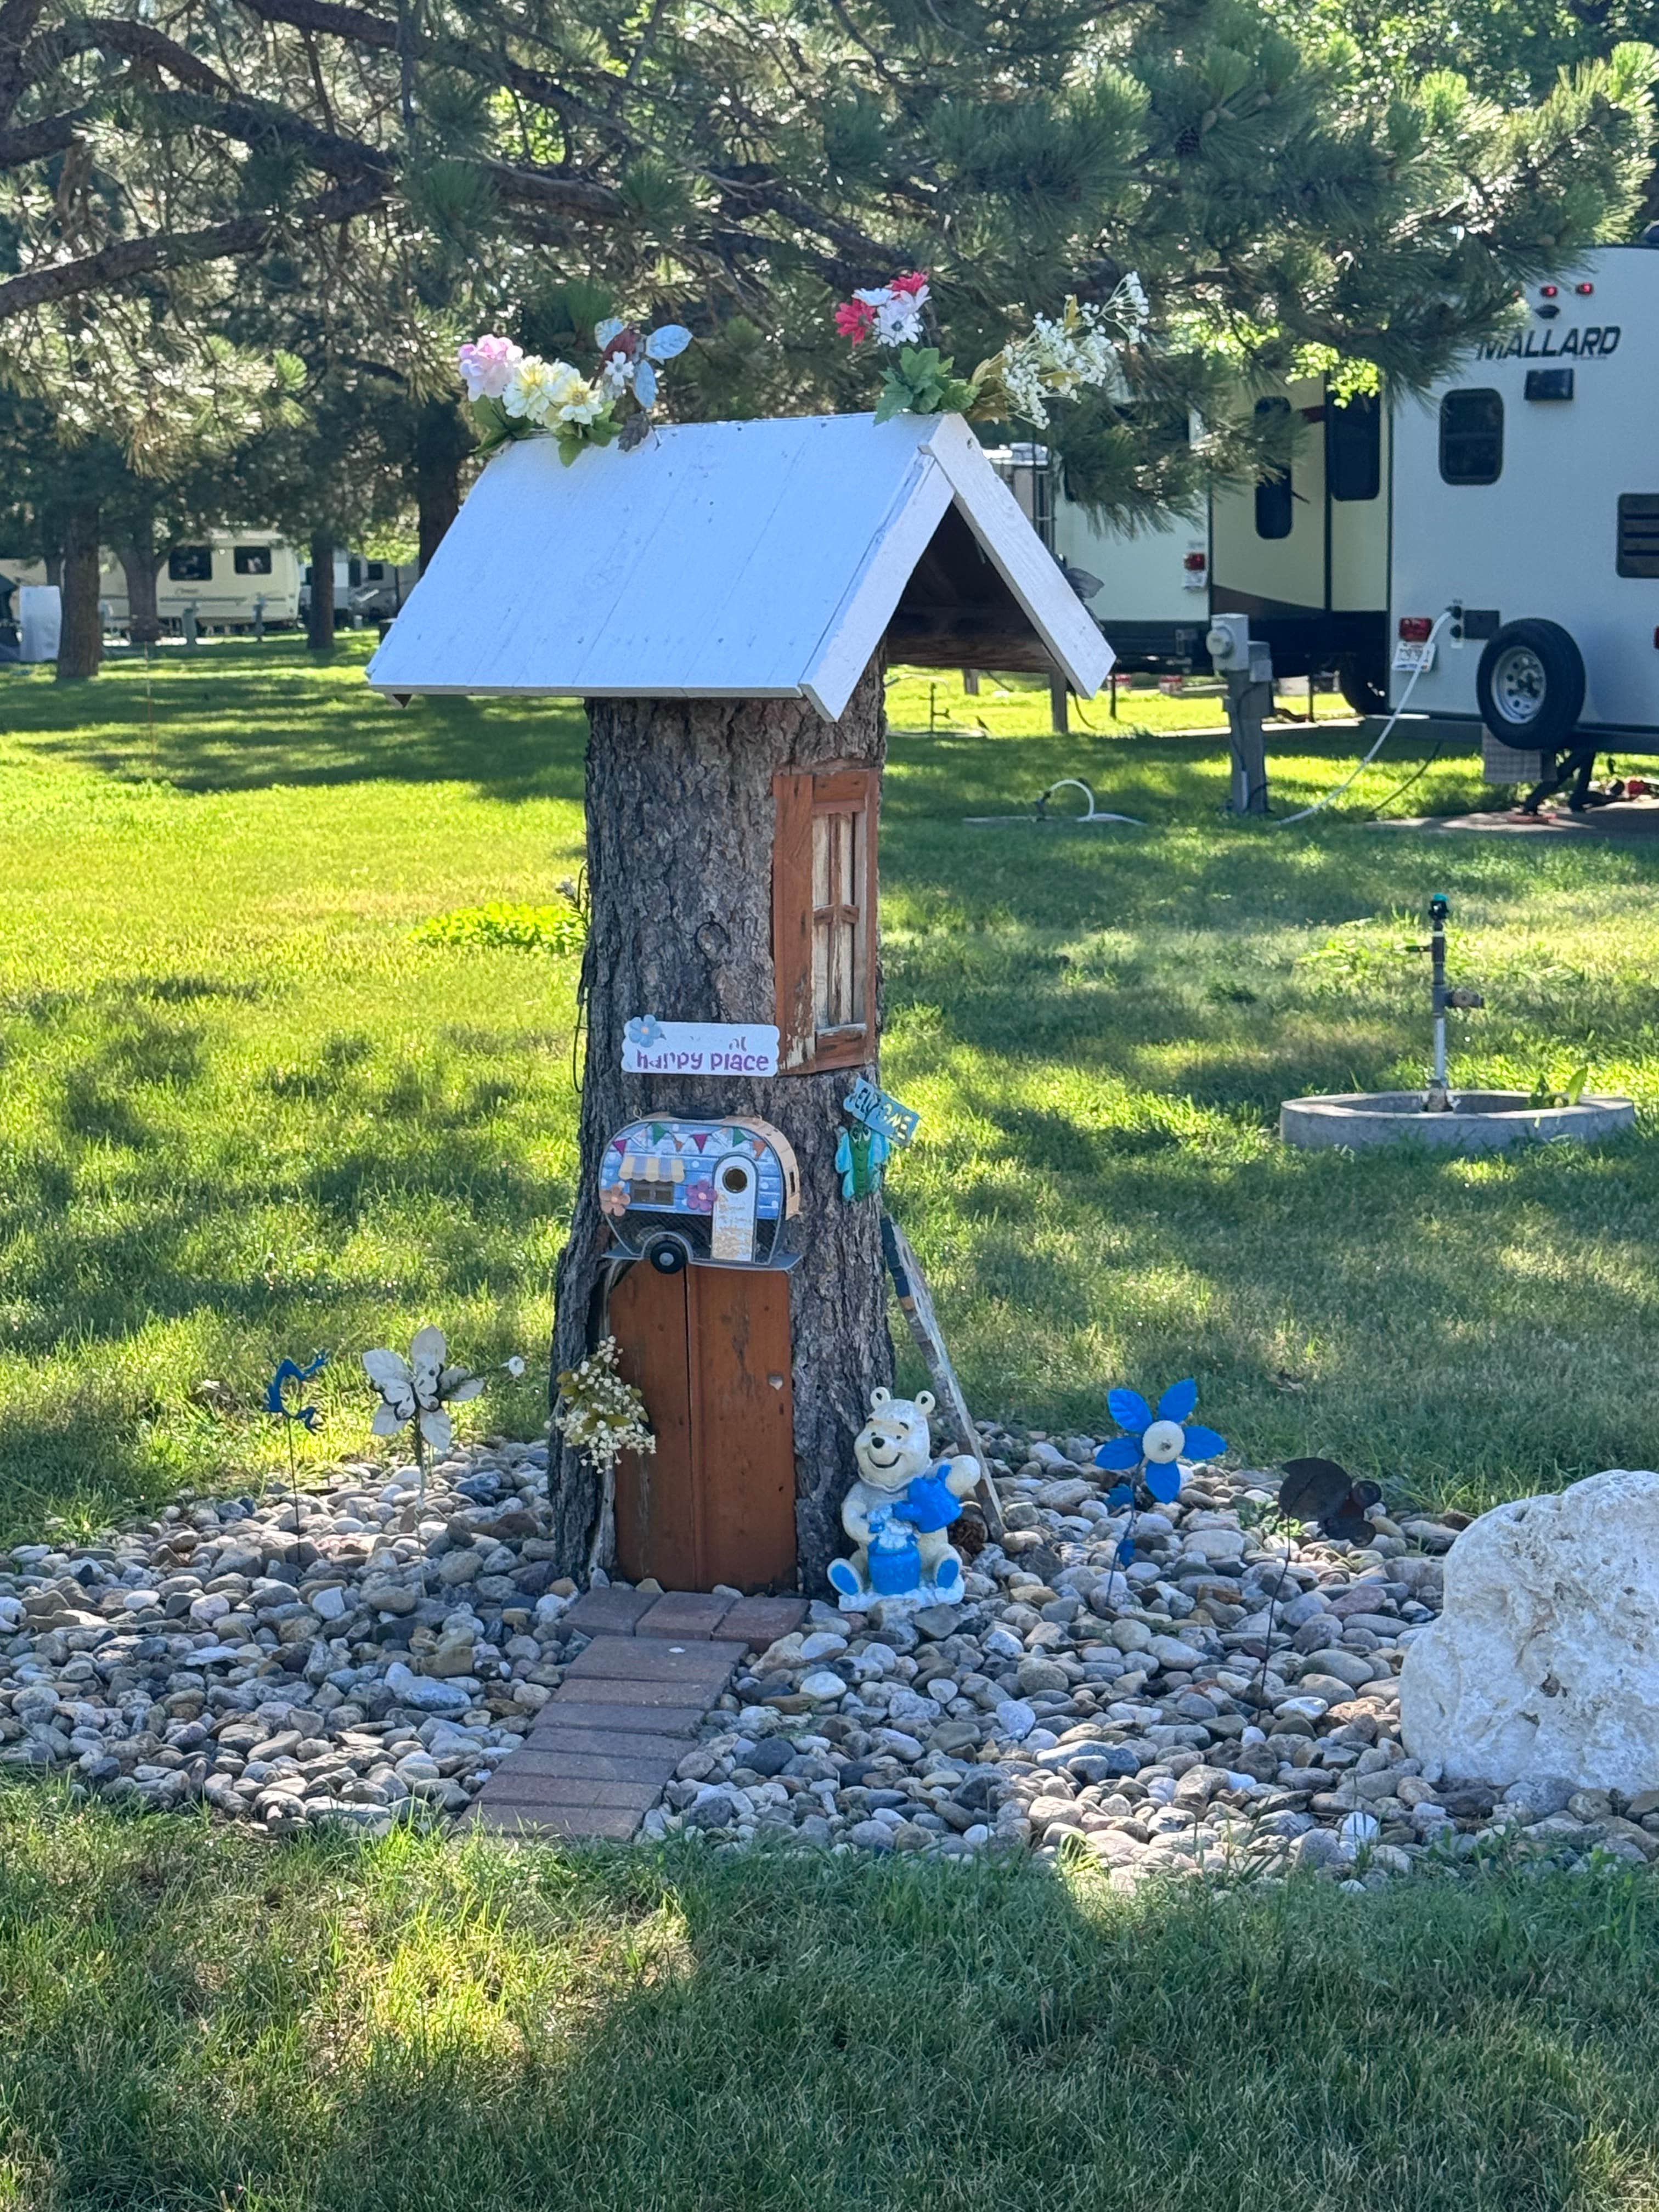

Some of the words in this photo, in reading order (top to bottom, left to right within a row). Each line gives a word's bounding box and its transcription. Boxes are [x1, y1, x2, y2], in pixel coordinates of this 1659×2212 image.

[1476, 326, 1621, 360] MALLARD
[636, 1048, 703, 1070] happy
[710, 1053, 769, 1071] place
